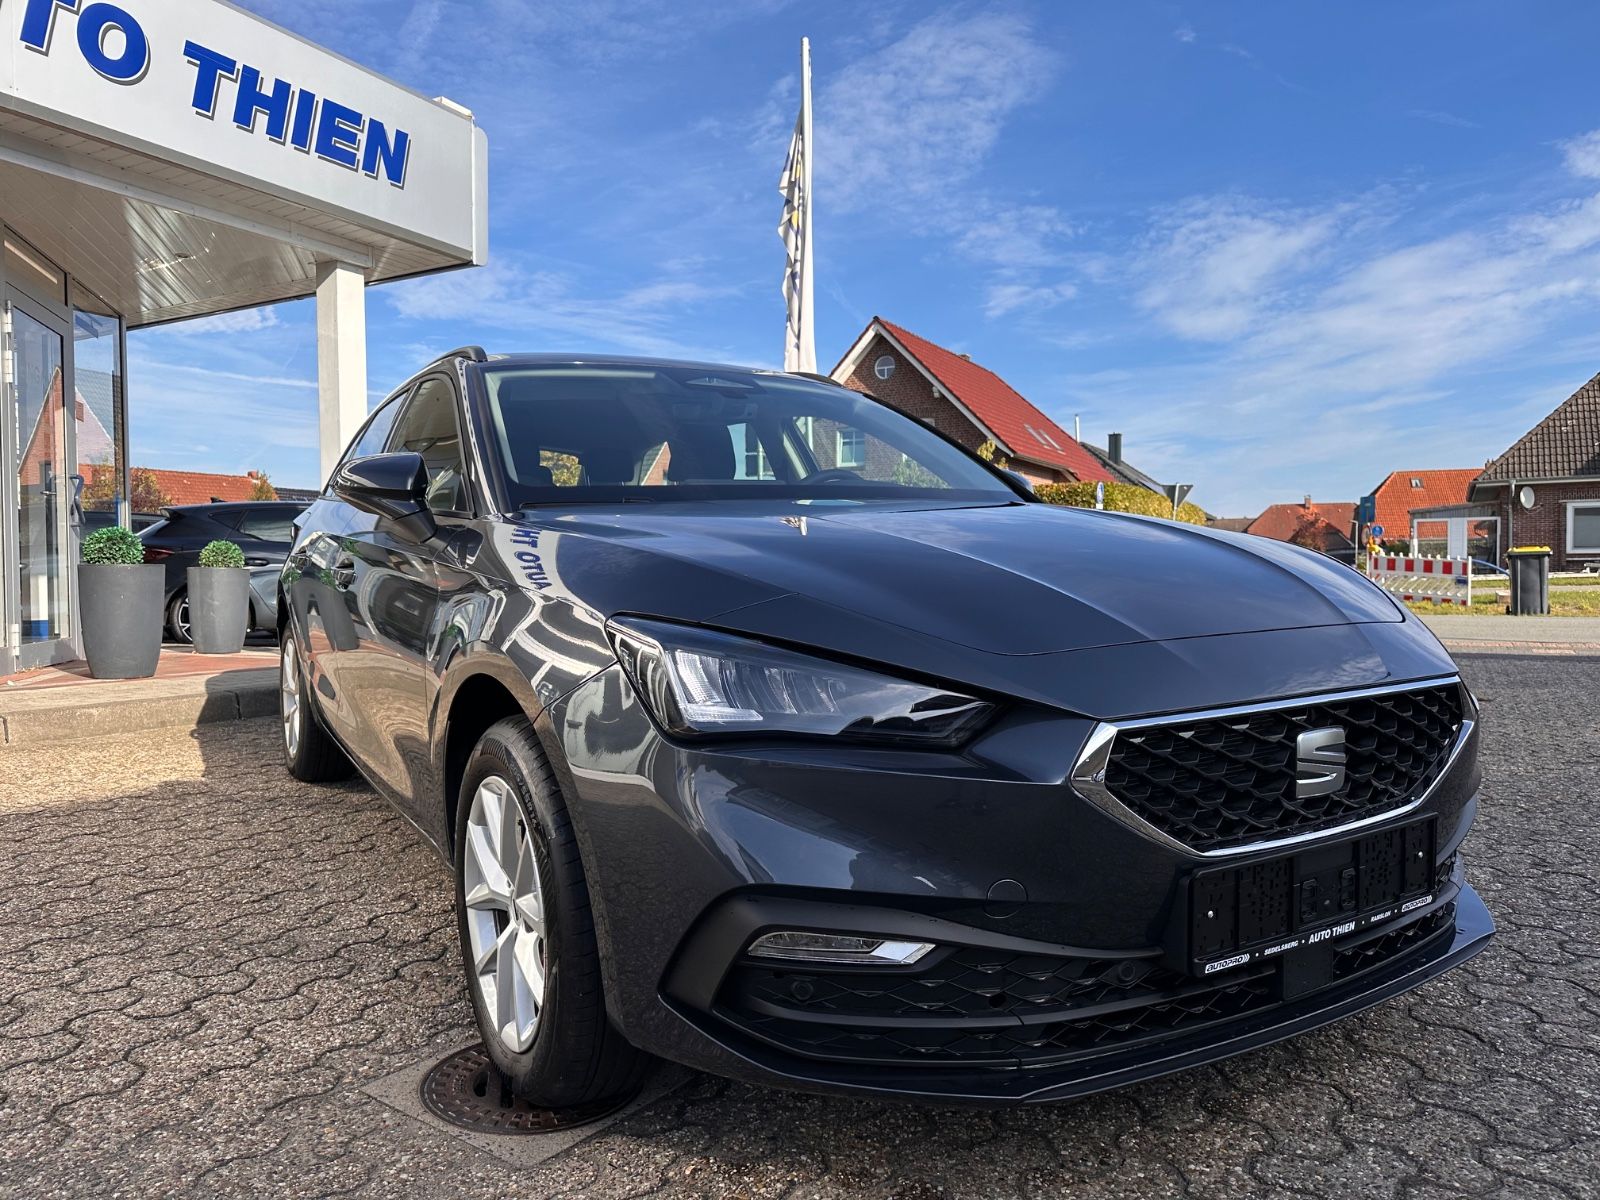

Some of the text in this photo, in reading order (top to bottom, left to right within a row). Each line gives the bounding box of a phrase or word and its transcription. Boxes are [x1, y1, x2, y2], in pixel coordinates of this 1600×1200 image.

[184, 40, 410, 189] THIEN
[1308, 929, 1332, 944] AUTO
[1332, 921, 1356, 938] THIEN
